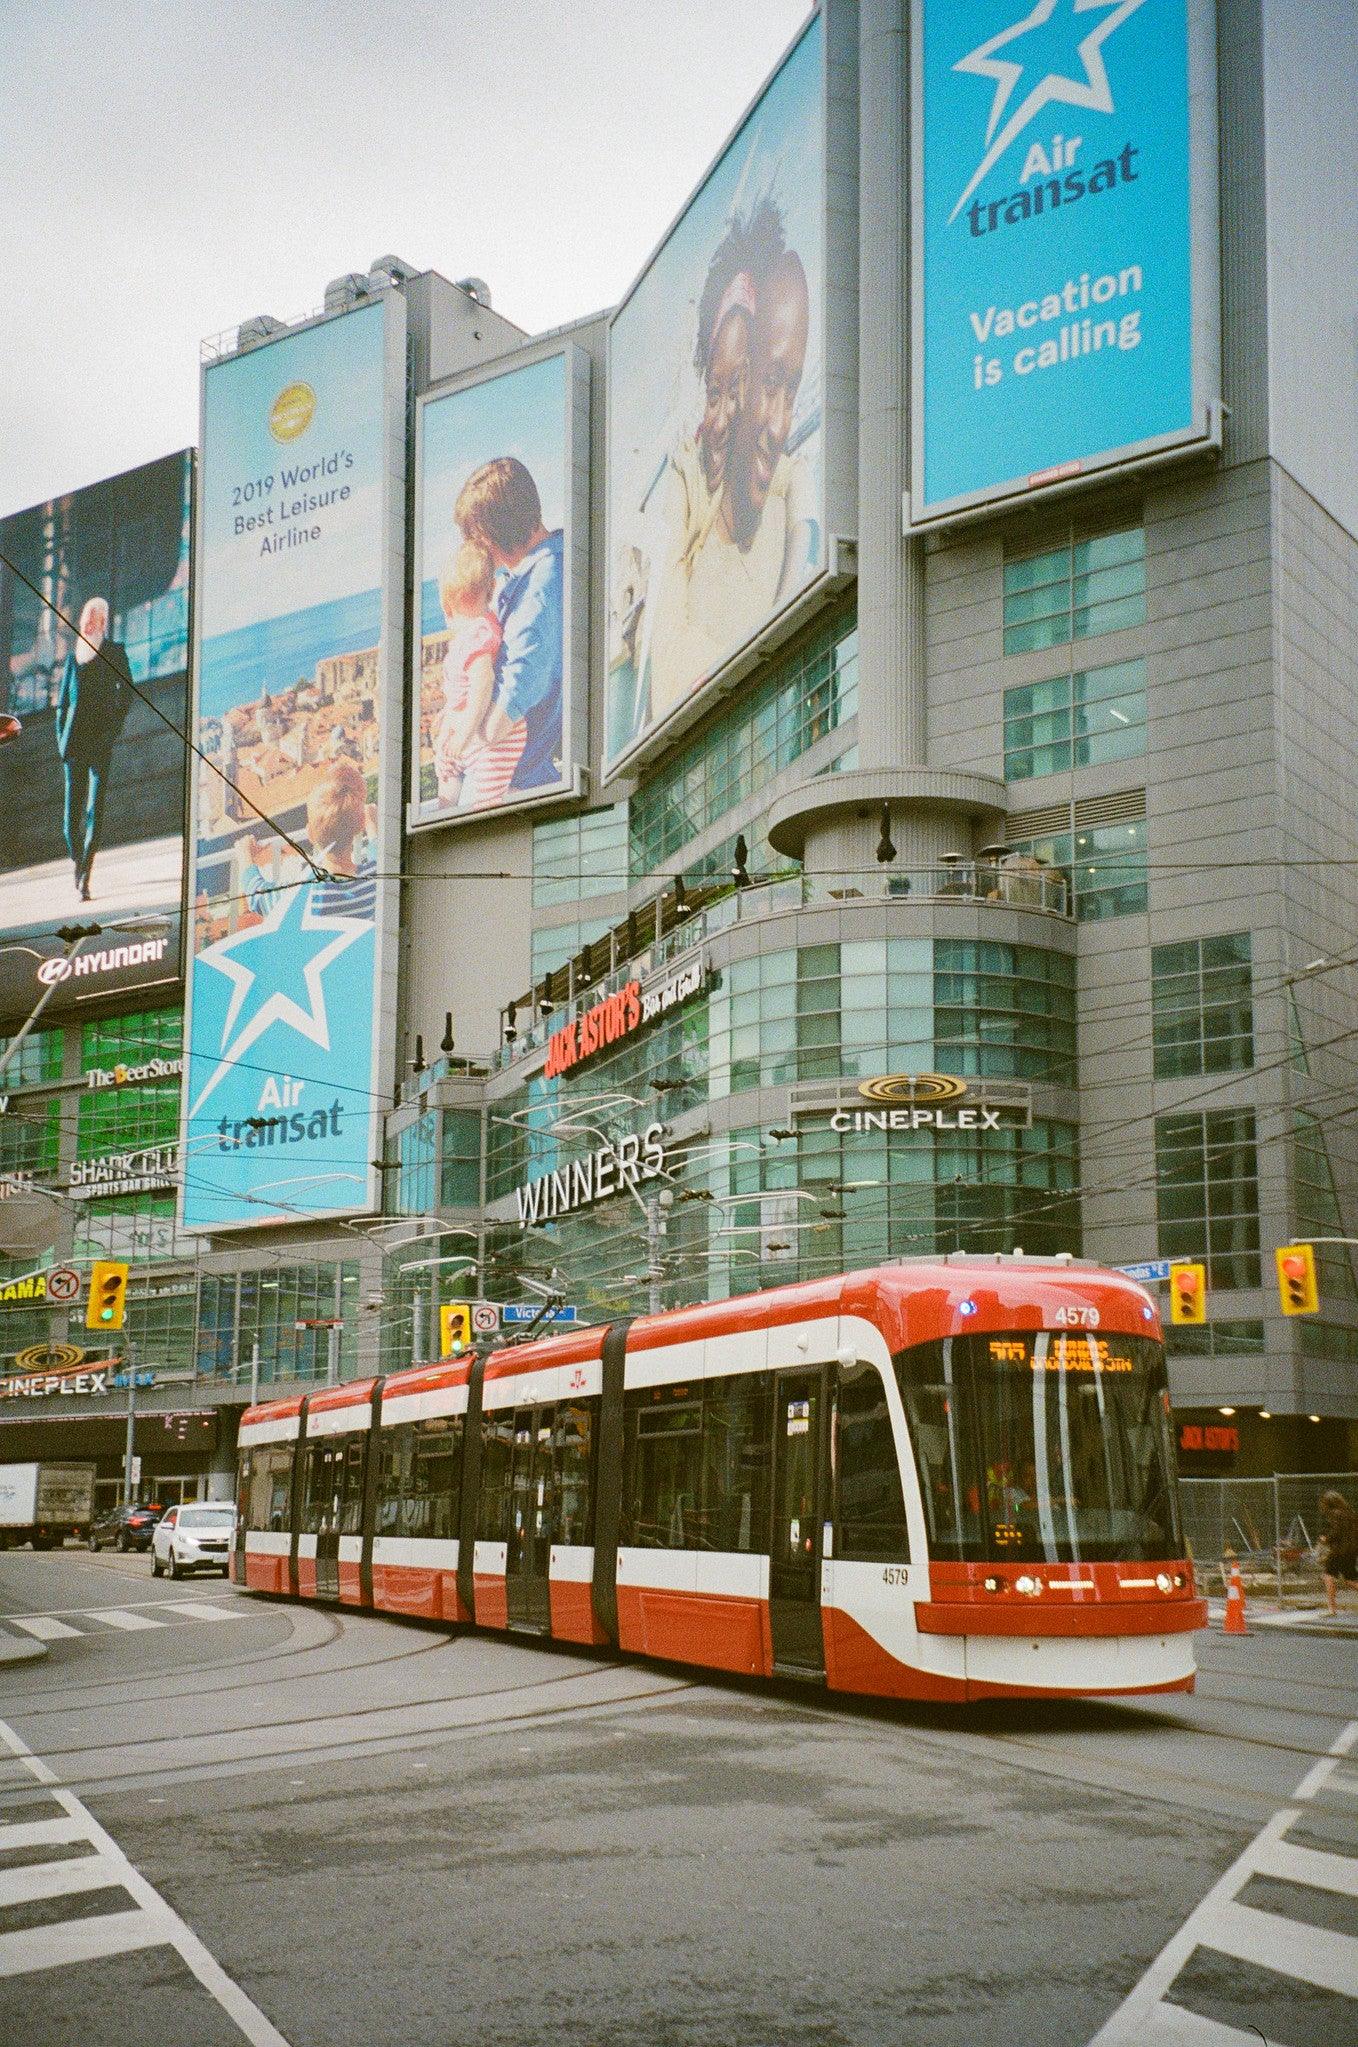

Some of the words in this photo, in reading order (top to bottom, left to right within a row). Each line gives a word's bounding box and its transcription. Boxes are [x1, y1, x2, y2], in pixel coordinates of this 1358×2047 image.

[1019, 134, 1083, 184] Air
[967, 142, 1140, 238] transat
[969, 264, 1143, 343] Vacation
[973, 355, 1002, 390] is
[1013, 310, 1142, 375] calling
[231, 475, 275, 507] 2019
[280, 450, 354, 489] World's
[233, 507, 273, 536] Best
[280, 485, 351, 520] Leisure
[259, 524, 322, 557] Airline
[74, 940, 164, 976] HYUNDAI
[544, 1022, 577, 1079] JACK
[579, 979, 641, 1059] ASTOR'S
[87, 1069, 115, 1088] The
[257, 1075, 304, 1111] Air
[217, 1098, 344, 1152] transat
[830, 1110, 1000, 1131] CINEPLEX
[516, 1123, 664, 1229] WINNERS
[0, 1276, 46, 1300] AMA
[1055, 1307, 1100, 1325] 4579
[882, 1567, 909, 1585] 4579
